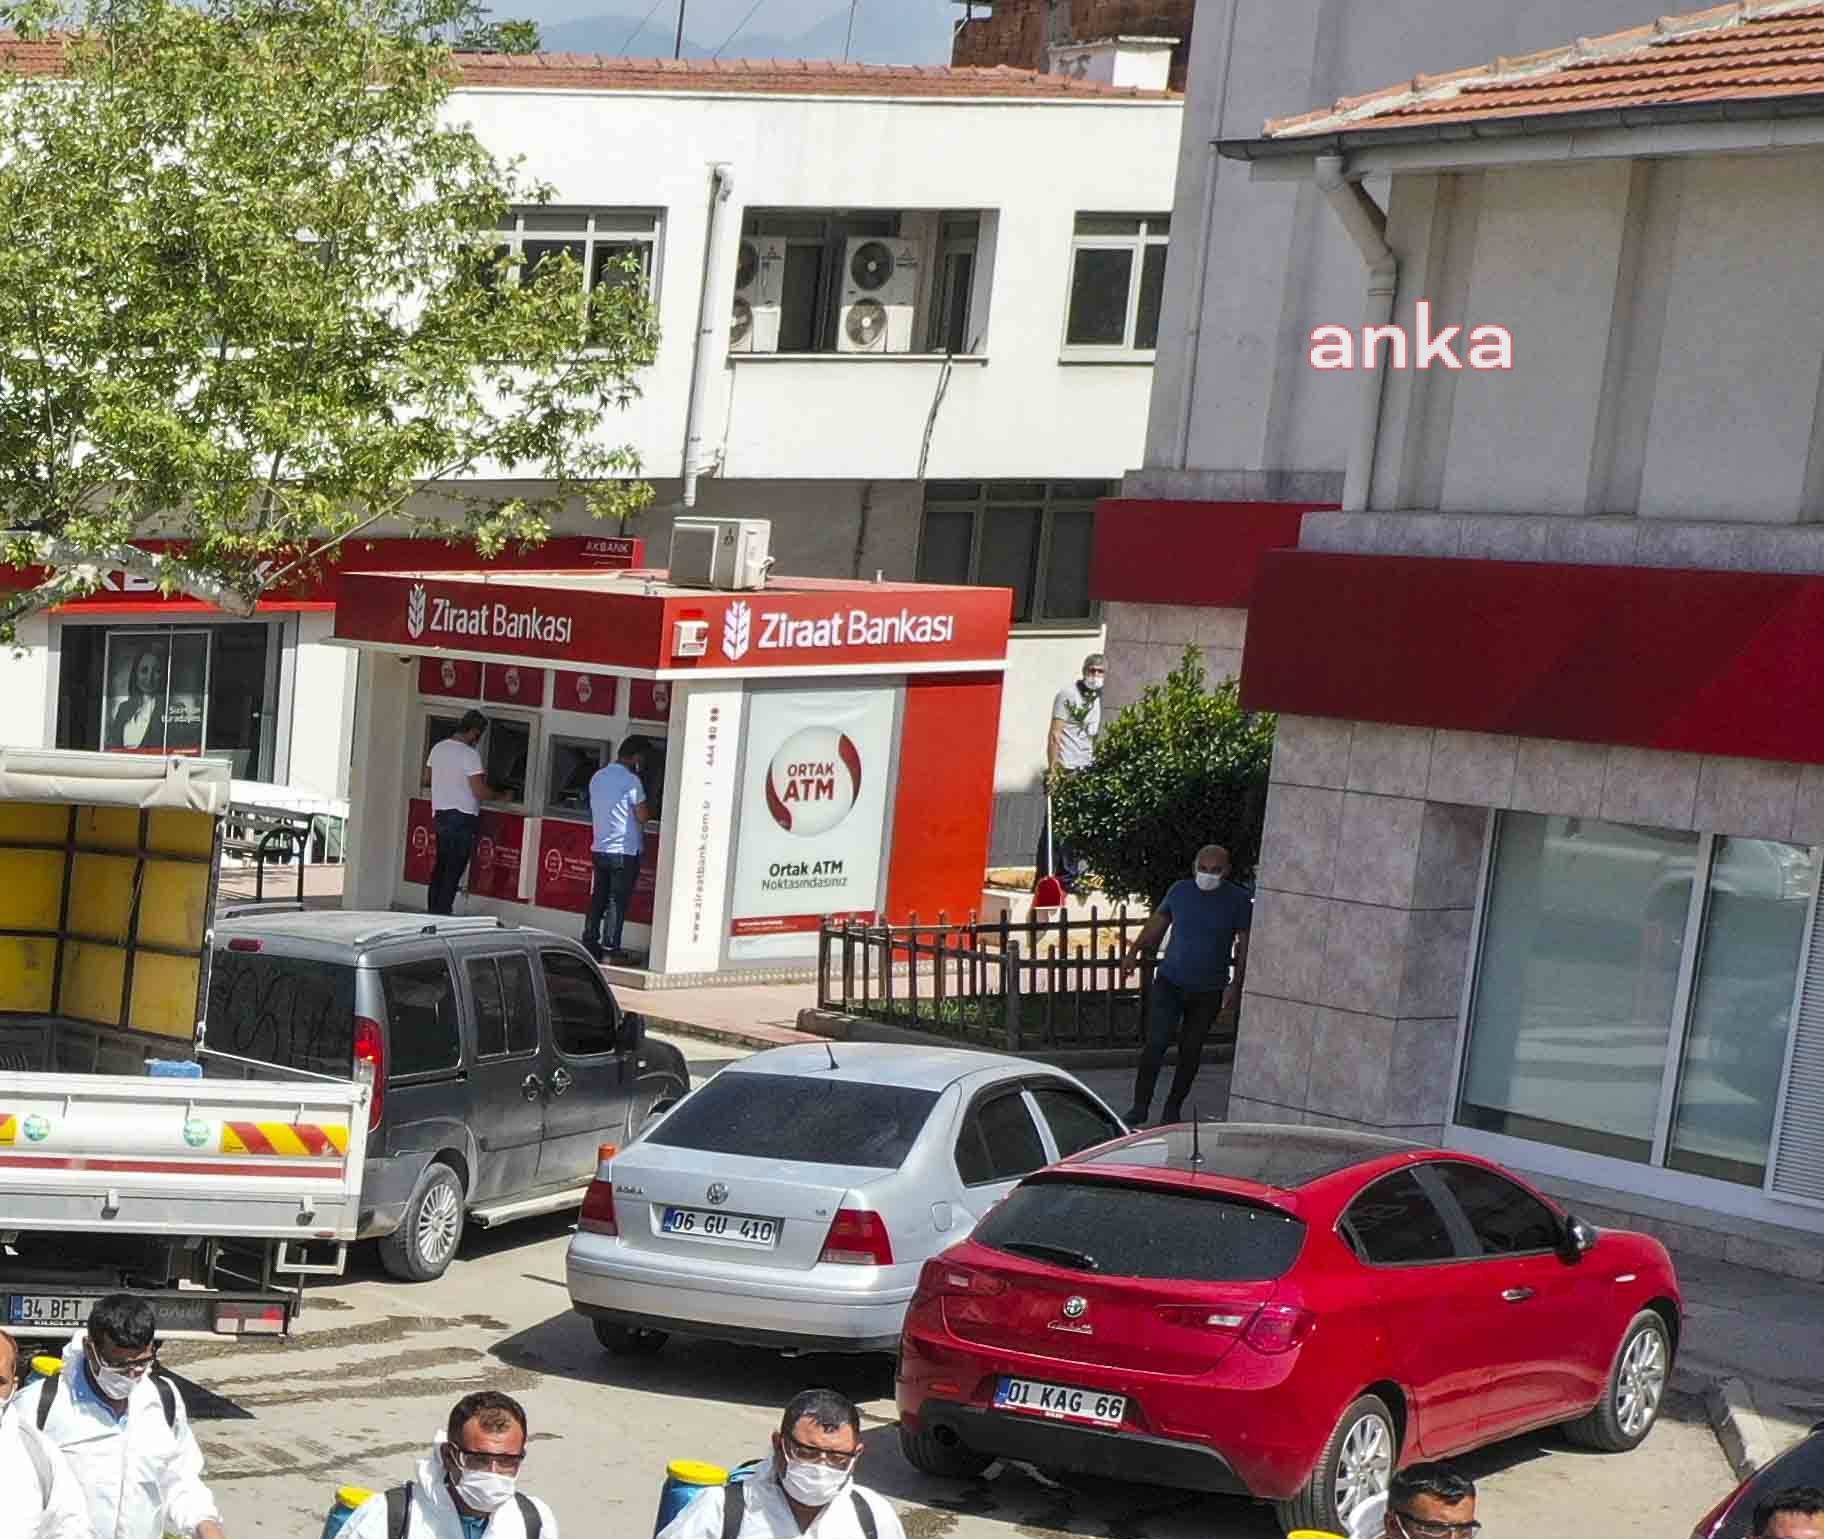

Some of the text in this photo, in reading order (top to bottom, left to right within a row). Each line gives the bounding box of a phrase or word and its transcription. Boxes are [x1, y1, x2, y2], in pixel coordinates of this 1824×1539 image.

[431, 601, 572, 643] Ziraat Bankası
[758, 608, 954, 650] Ziraat Bankası
[787, 762, 835, 777] ORTAK
[783, 779, 835, 801] ATM
[769, 859, 843, 877] Ortak ATM
[673, 1211, 773, 1242] 06 GU 410
[23, 1299, 81, 1320] 34 BFT
[1008, 1382, 1123, 1419] 01 KAG 66
